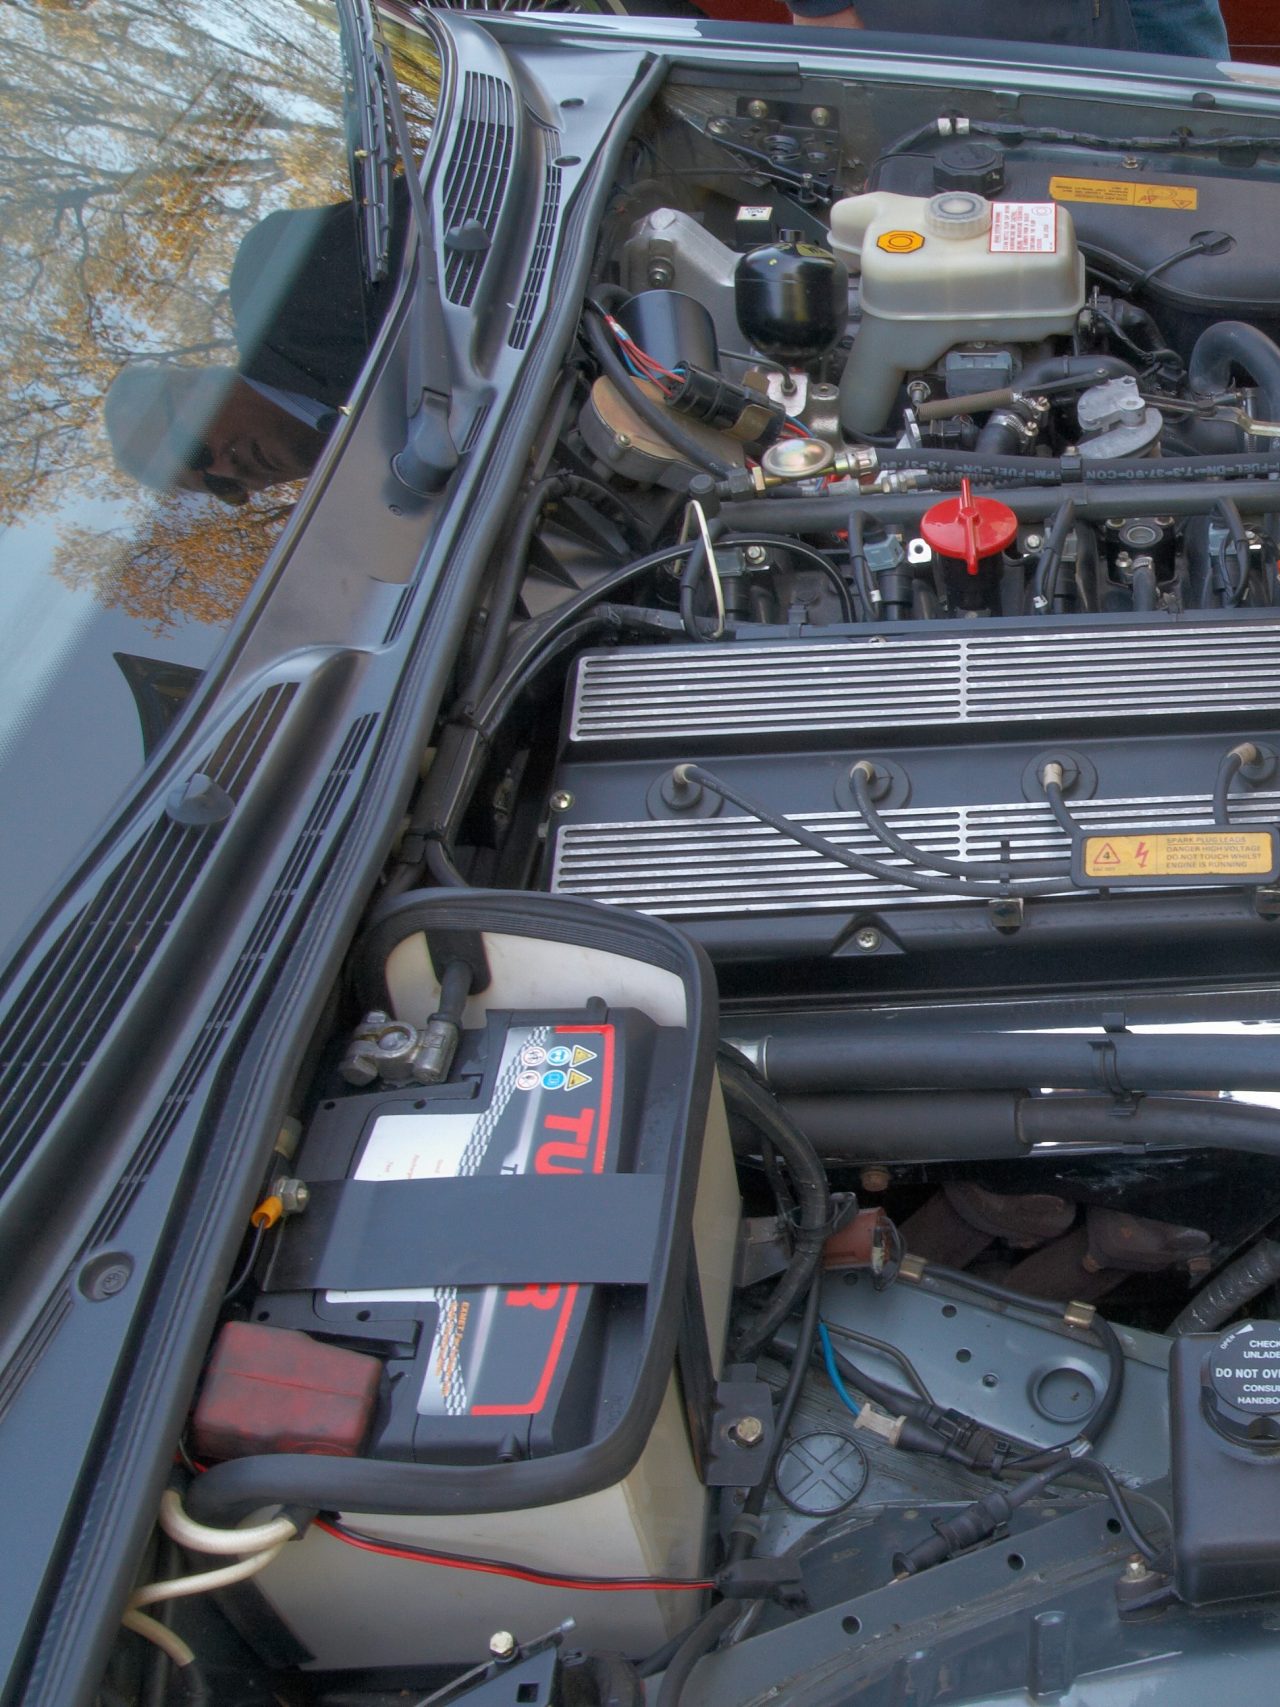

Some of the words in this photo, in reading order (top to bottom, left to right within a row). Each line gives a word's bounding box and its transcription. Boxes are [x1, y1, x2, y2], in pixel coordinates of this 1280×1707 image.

[1102, 852, 1111, 860] 4
[1230, 852, 1262, 860] WHILST
[1220, 1334, 1236, 1350] OPEN
[1216, 1368, 1232, 1378] DO
[1235, 1368, 1259, 1378] NOT
